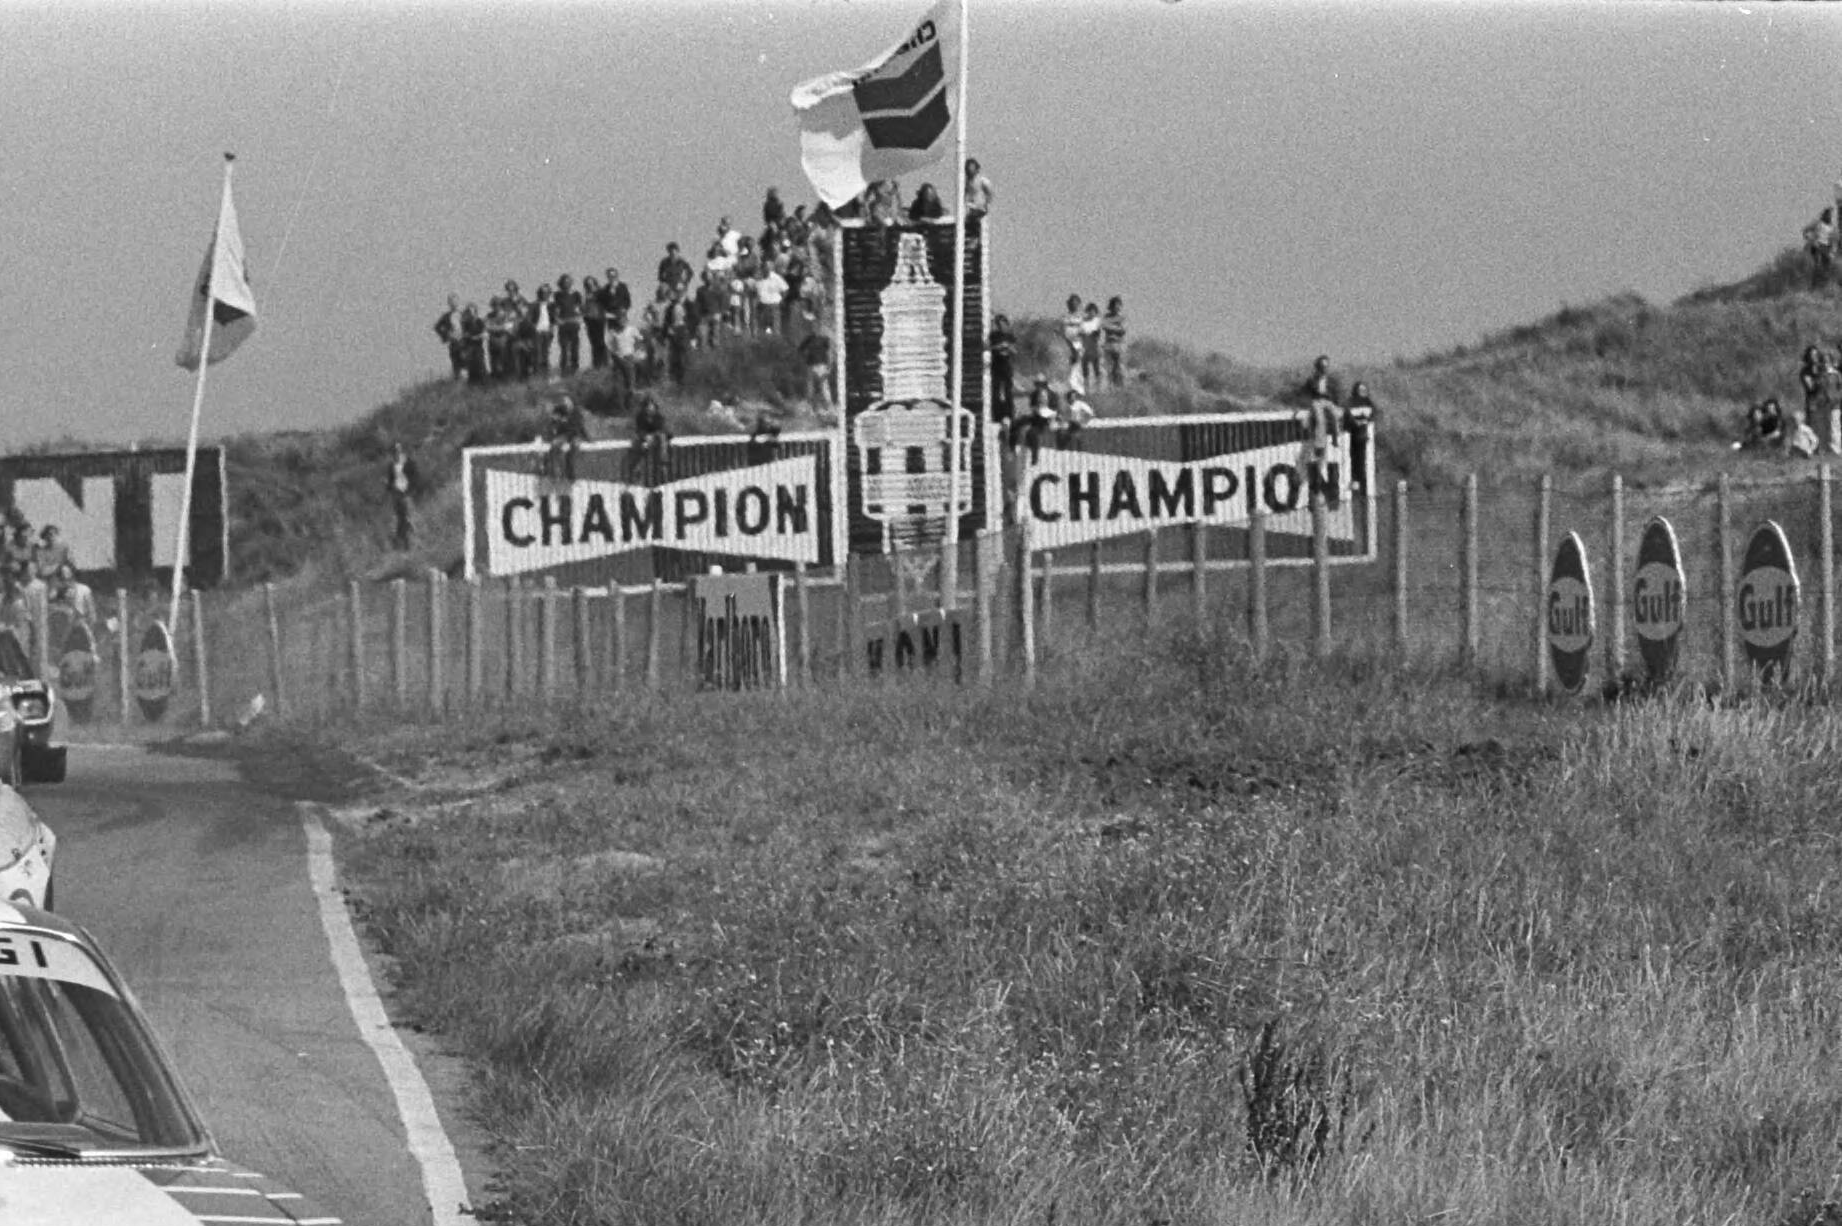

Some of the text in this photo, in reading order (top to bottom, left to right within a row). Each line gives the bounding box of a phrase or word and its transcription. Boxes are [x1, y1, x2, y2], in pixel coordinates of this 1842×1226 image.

[502, 484, 808, 548] CHAMPION
[1029, 462, 1340, 523] CHAMPION
[1549, 591, 1589, 636] Gulf
[1630, 578, 1681, 624] Gulf
[1739, 583, 1795, 631] Gulf
